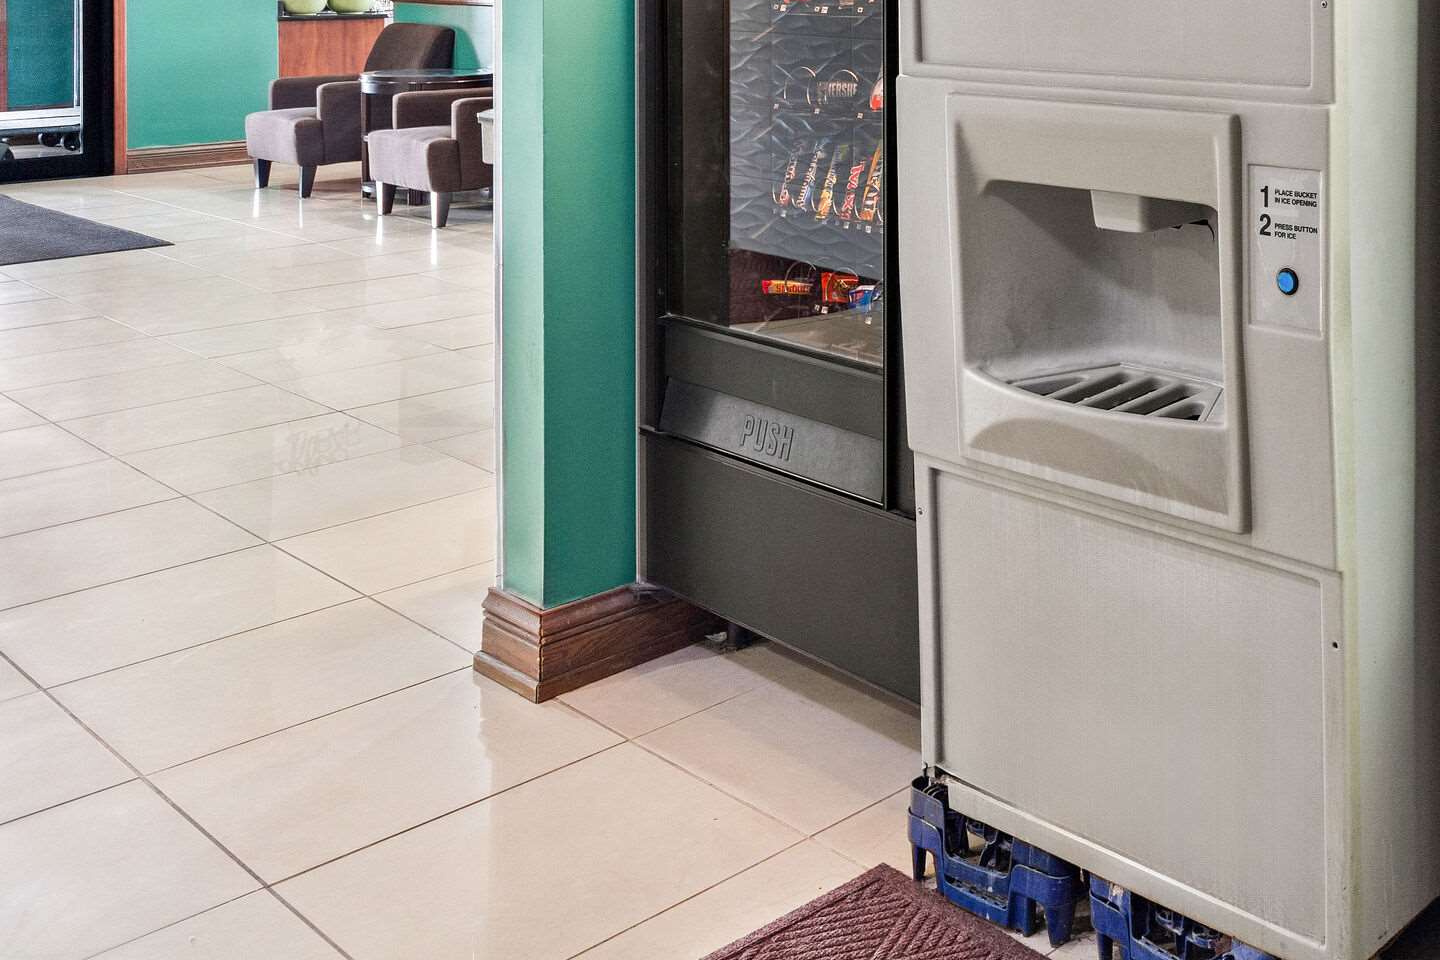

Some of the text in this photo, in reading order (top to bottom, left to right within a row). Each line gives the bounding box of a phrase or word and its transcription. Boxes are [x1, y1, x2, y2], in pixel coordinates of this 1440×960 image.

[1260, 185, 1318, 208] 1 PLACE BUCKET
[1291, 199, 1318, 208] OPENING
[1260, 214, 1318, 236] 2 PRESS BUTTON
[1274, 231, 1286, 239] FOR
[740, 415, 796, 462] PUSH
